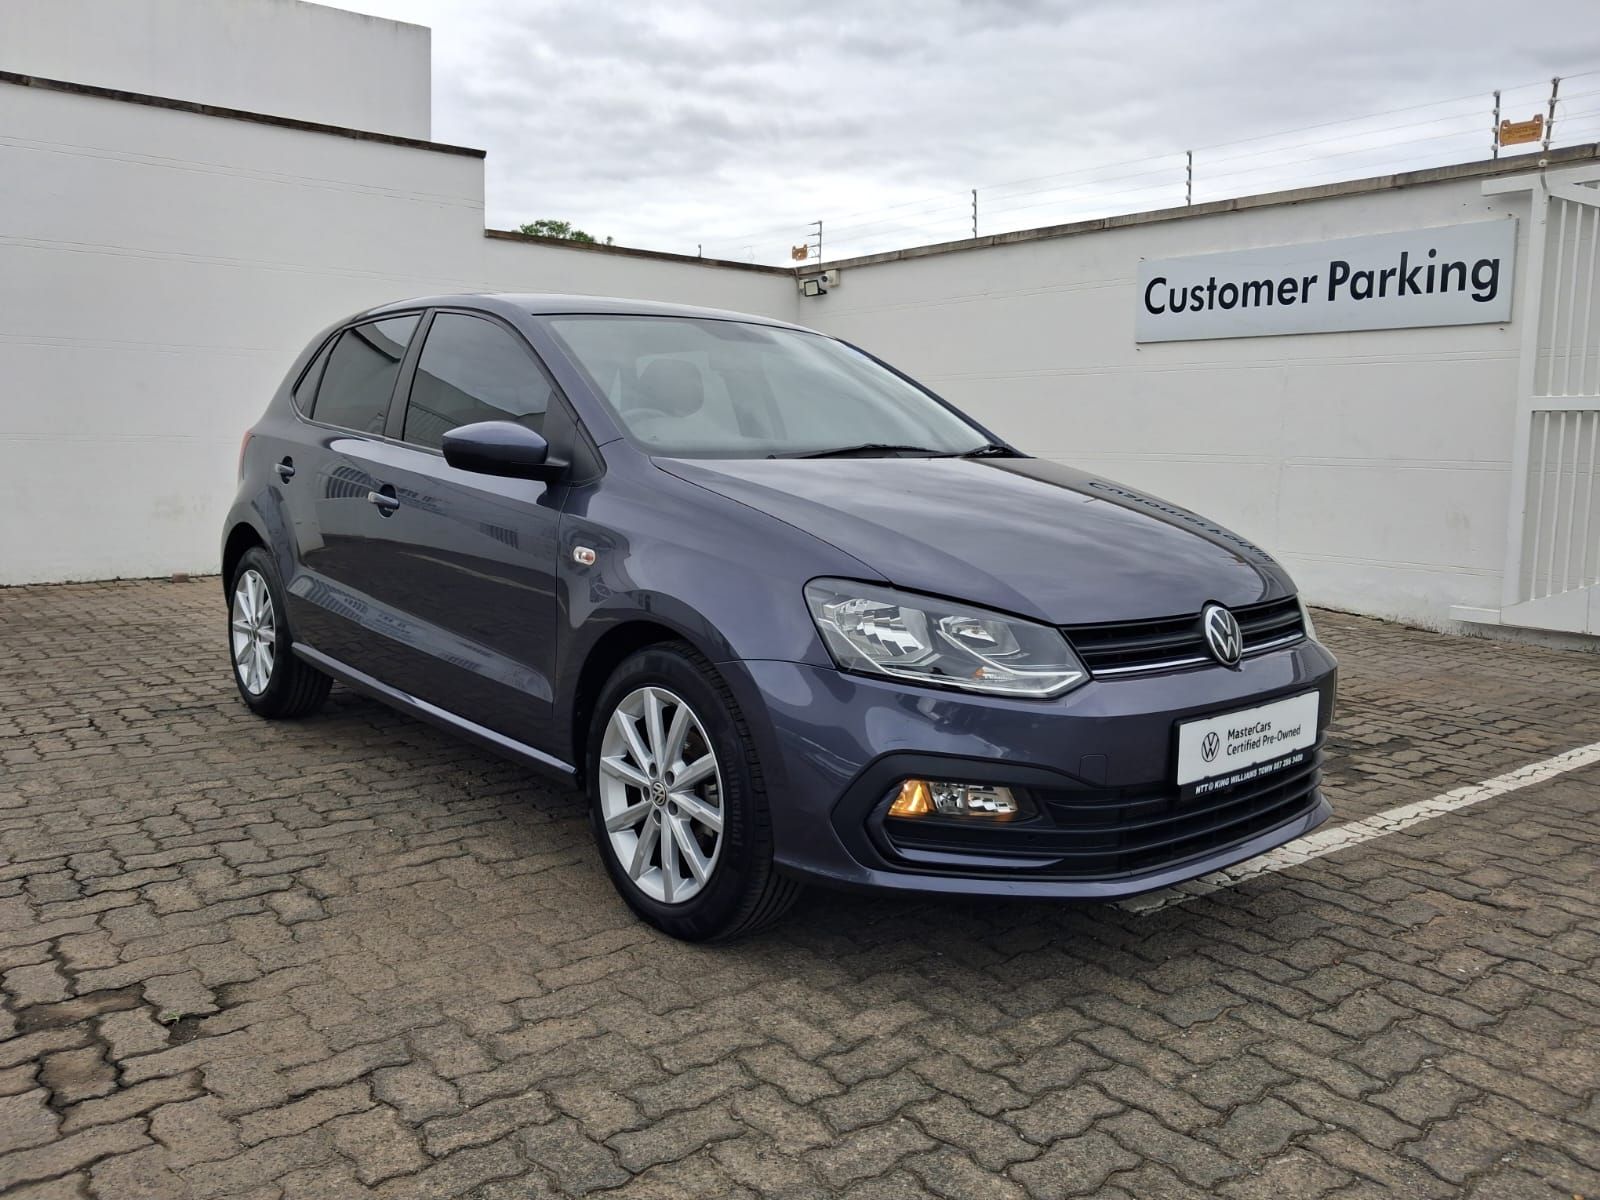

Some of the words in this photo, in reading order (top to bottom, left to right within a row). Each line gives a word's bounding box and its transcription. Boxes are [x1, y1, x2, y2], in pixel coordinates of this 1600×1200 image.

[1144, 275, 1318, 314] Customer
[1328, 248, 1500, 302] Parking
[1205, 606, 1242, 665] VW
[1227, 721, 1271, 740] MasterCars
[1227, 737, 1260, 756] Certified
[1262, 724, 1301, 746] Pre-Owned
[1201, 731, 1220, 762] VW
[1214, 777, 1229, 790] KING
[1230, 768, 1257, 784] WILLIAMS
[1258, 763, 1273, 776] TOWN
